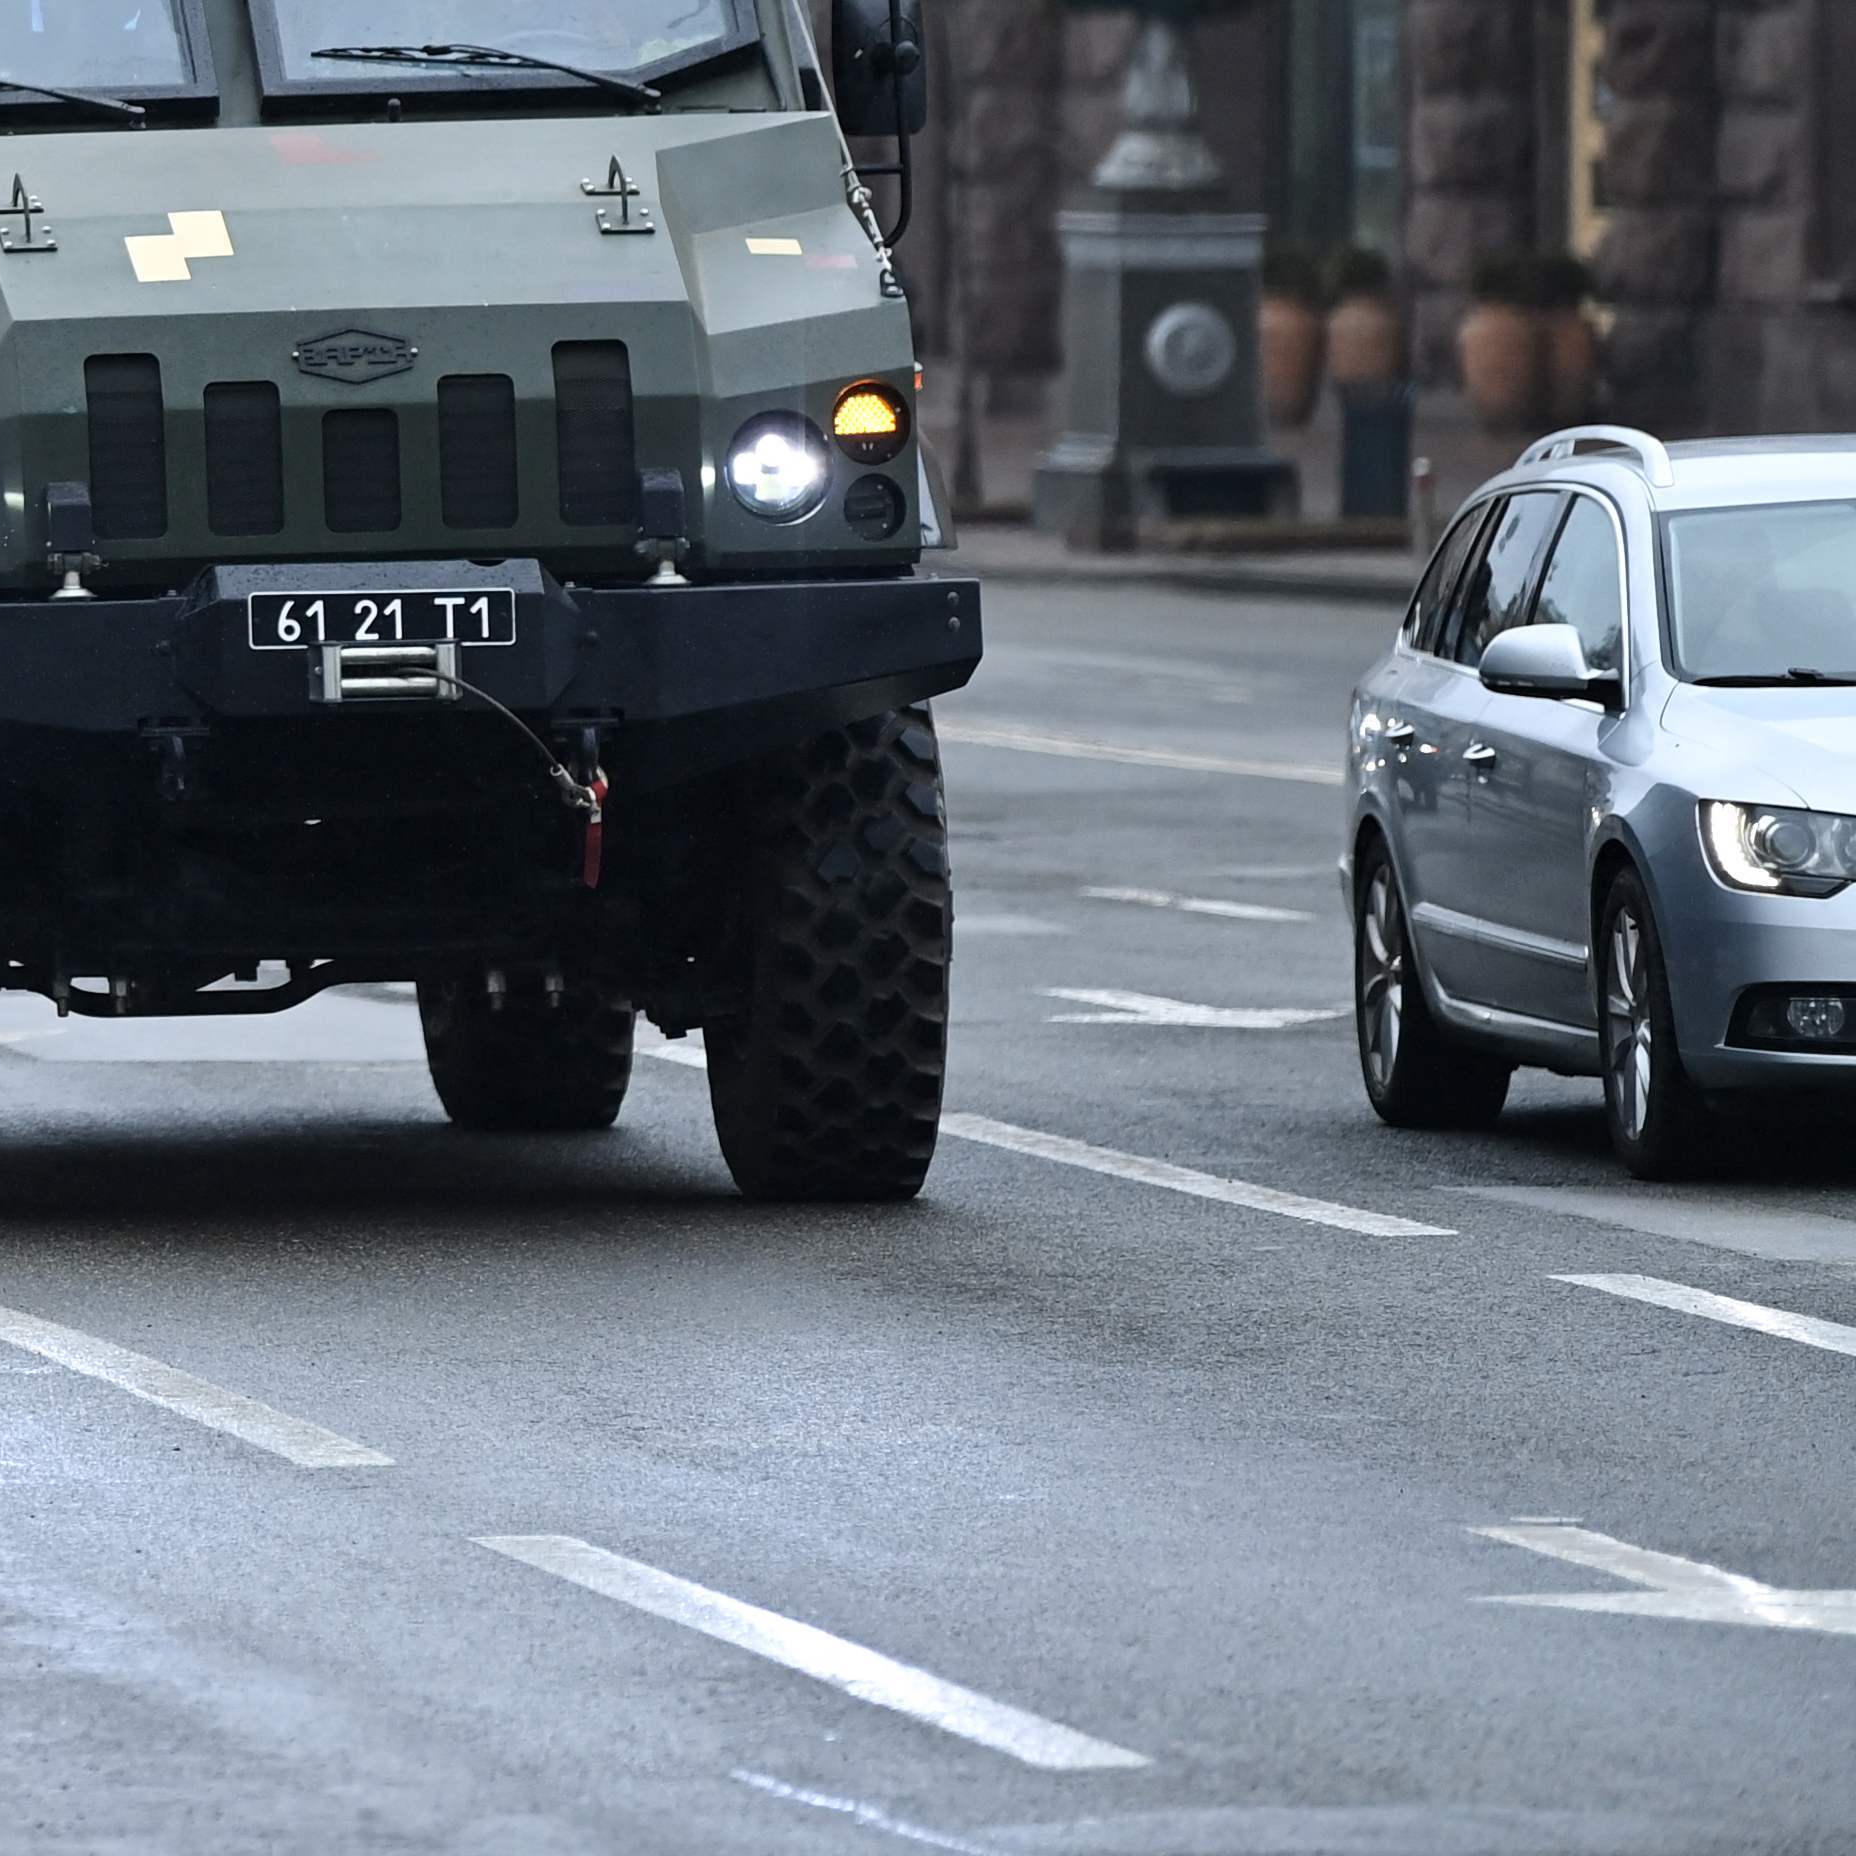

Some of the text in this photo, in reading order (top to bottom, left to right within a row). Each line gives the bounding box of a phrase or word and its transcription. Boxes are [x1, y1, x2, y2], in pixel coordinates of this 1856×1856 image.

[277, 596, 490, 642] 61 21 T1
